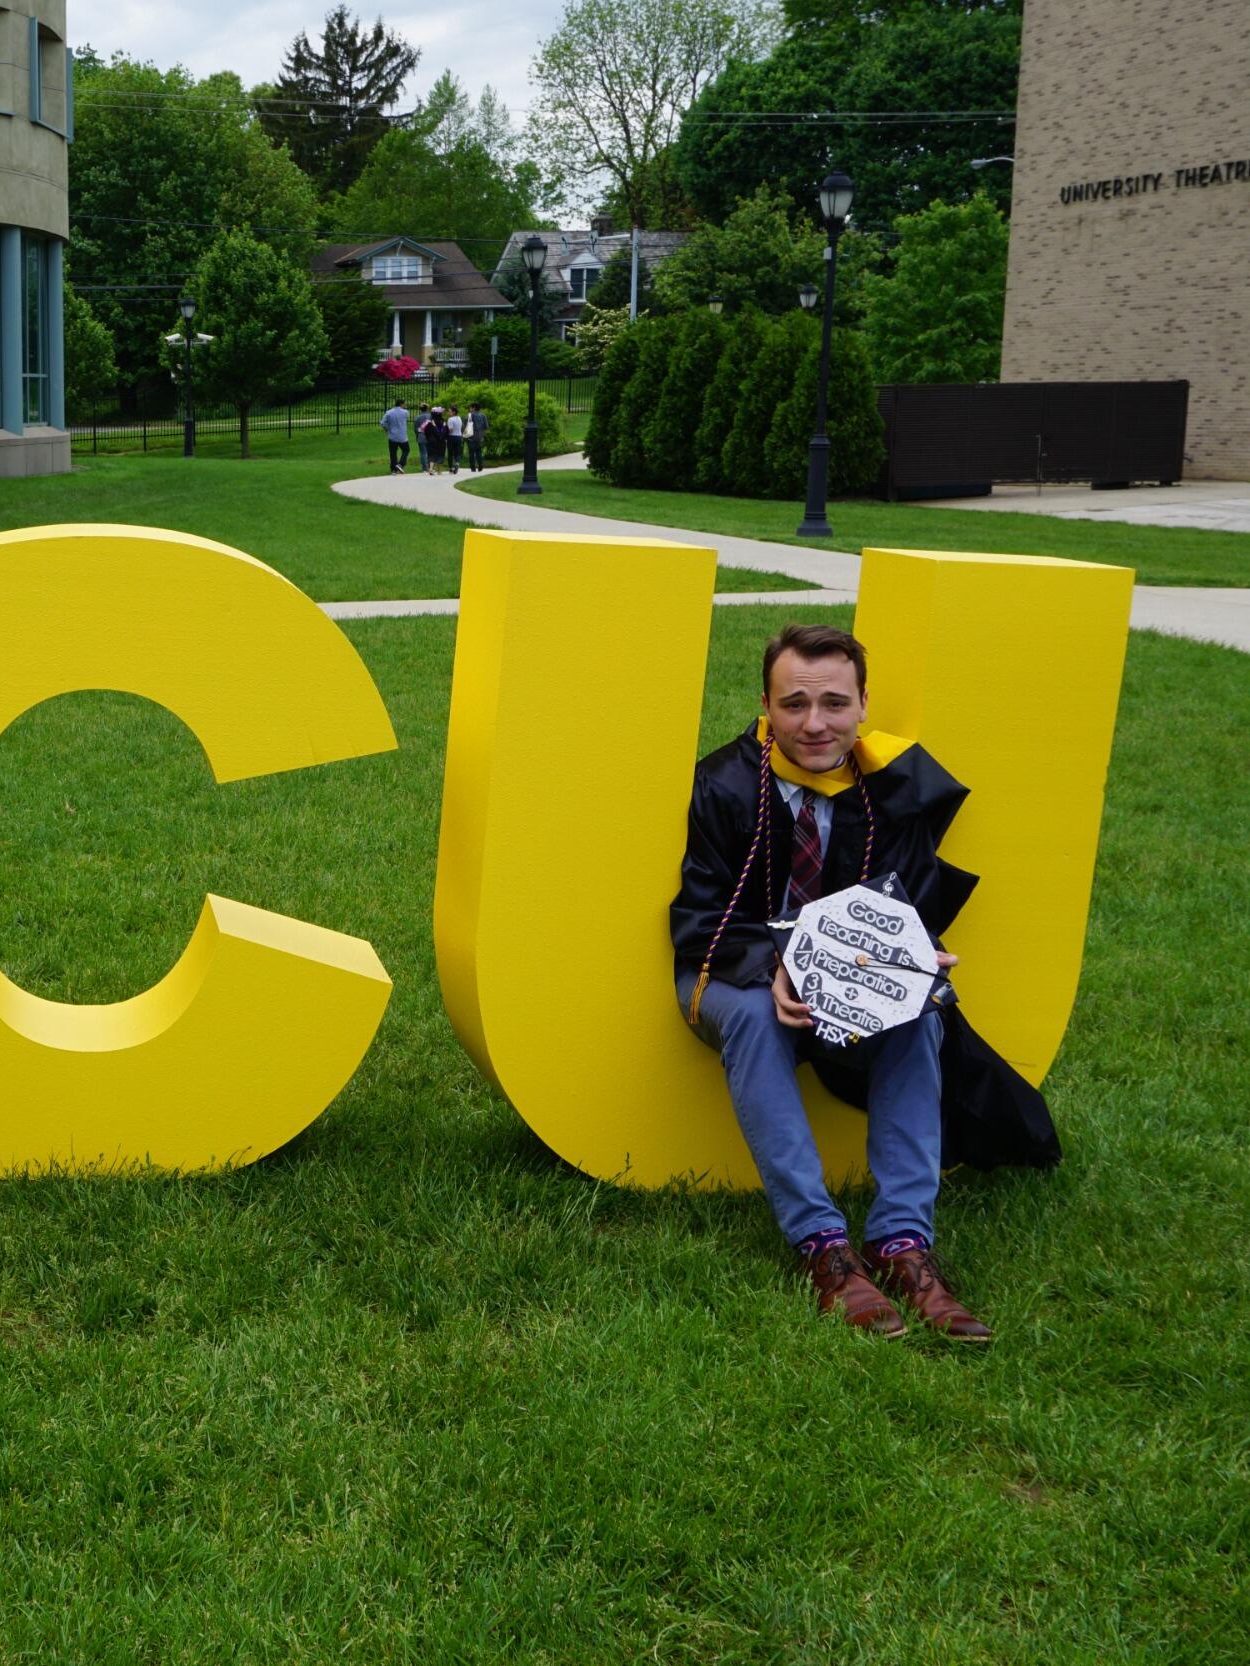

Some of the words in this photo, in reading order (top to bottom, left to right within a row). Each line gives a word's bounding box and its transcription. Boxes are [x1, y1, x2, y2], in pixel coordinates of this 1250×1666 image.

[1060, 172, 1163, 206] UNIVERSITY
[850, 901, 902, 934] Good
[820, 918, 893, 961] Teaching
[814, 949, 906, 1000] Preparation
[822, 993, 883, 1032] Theatre
[815, 1021, 849, 1048] HSX
